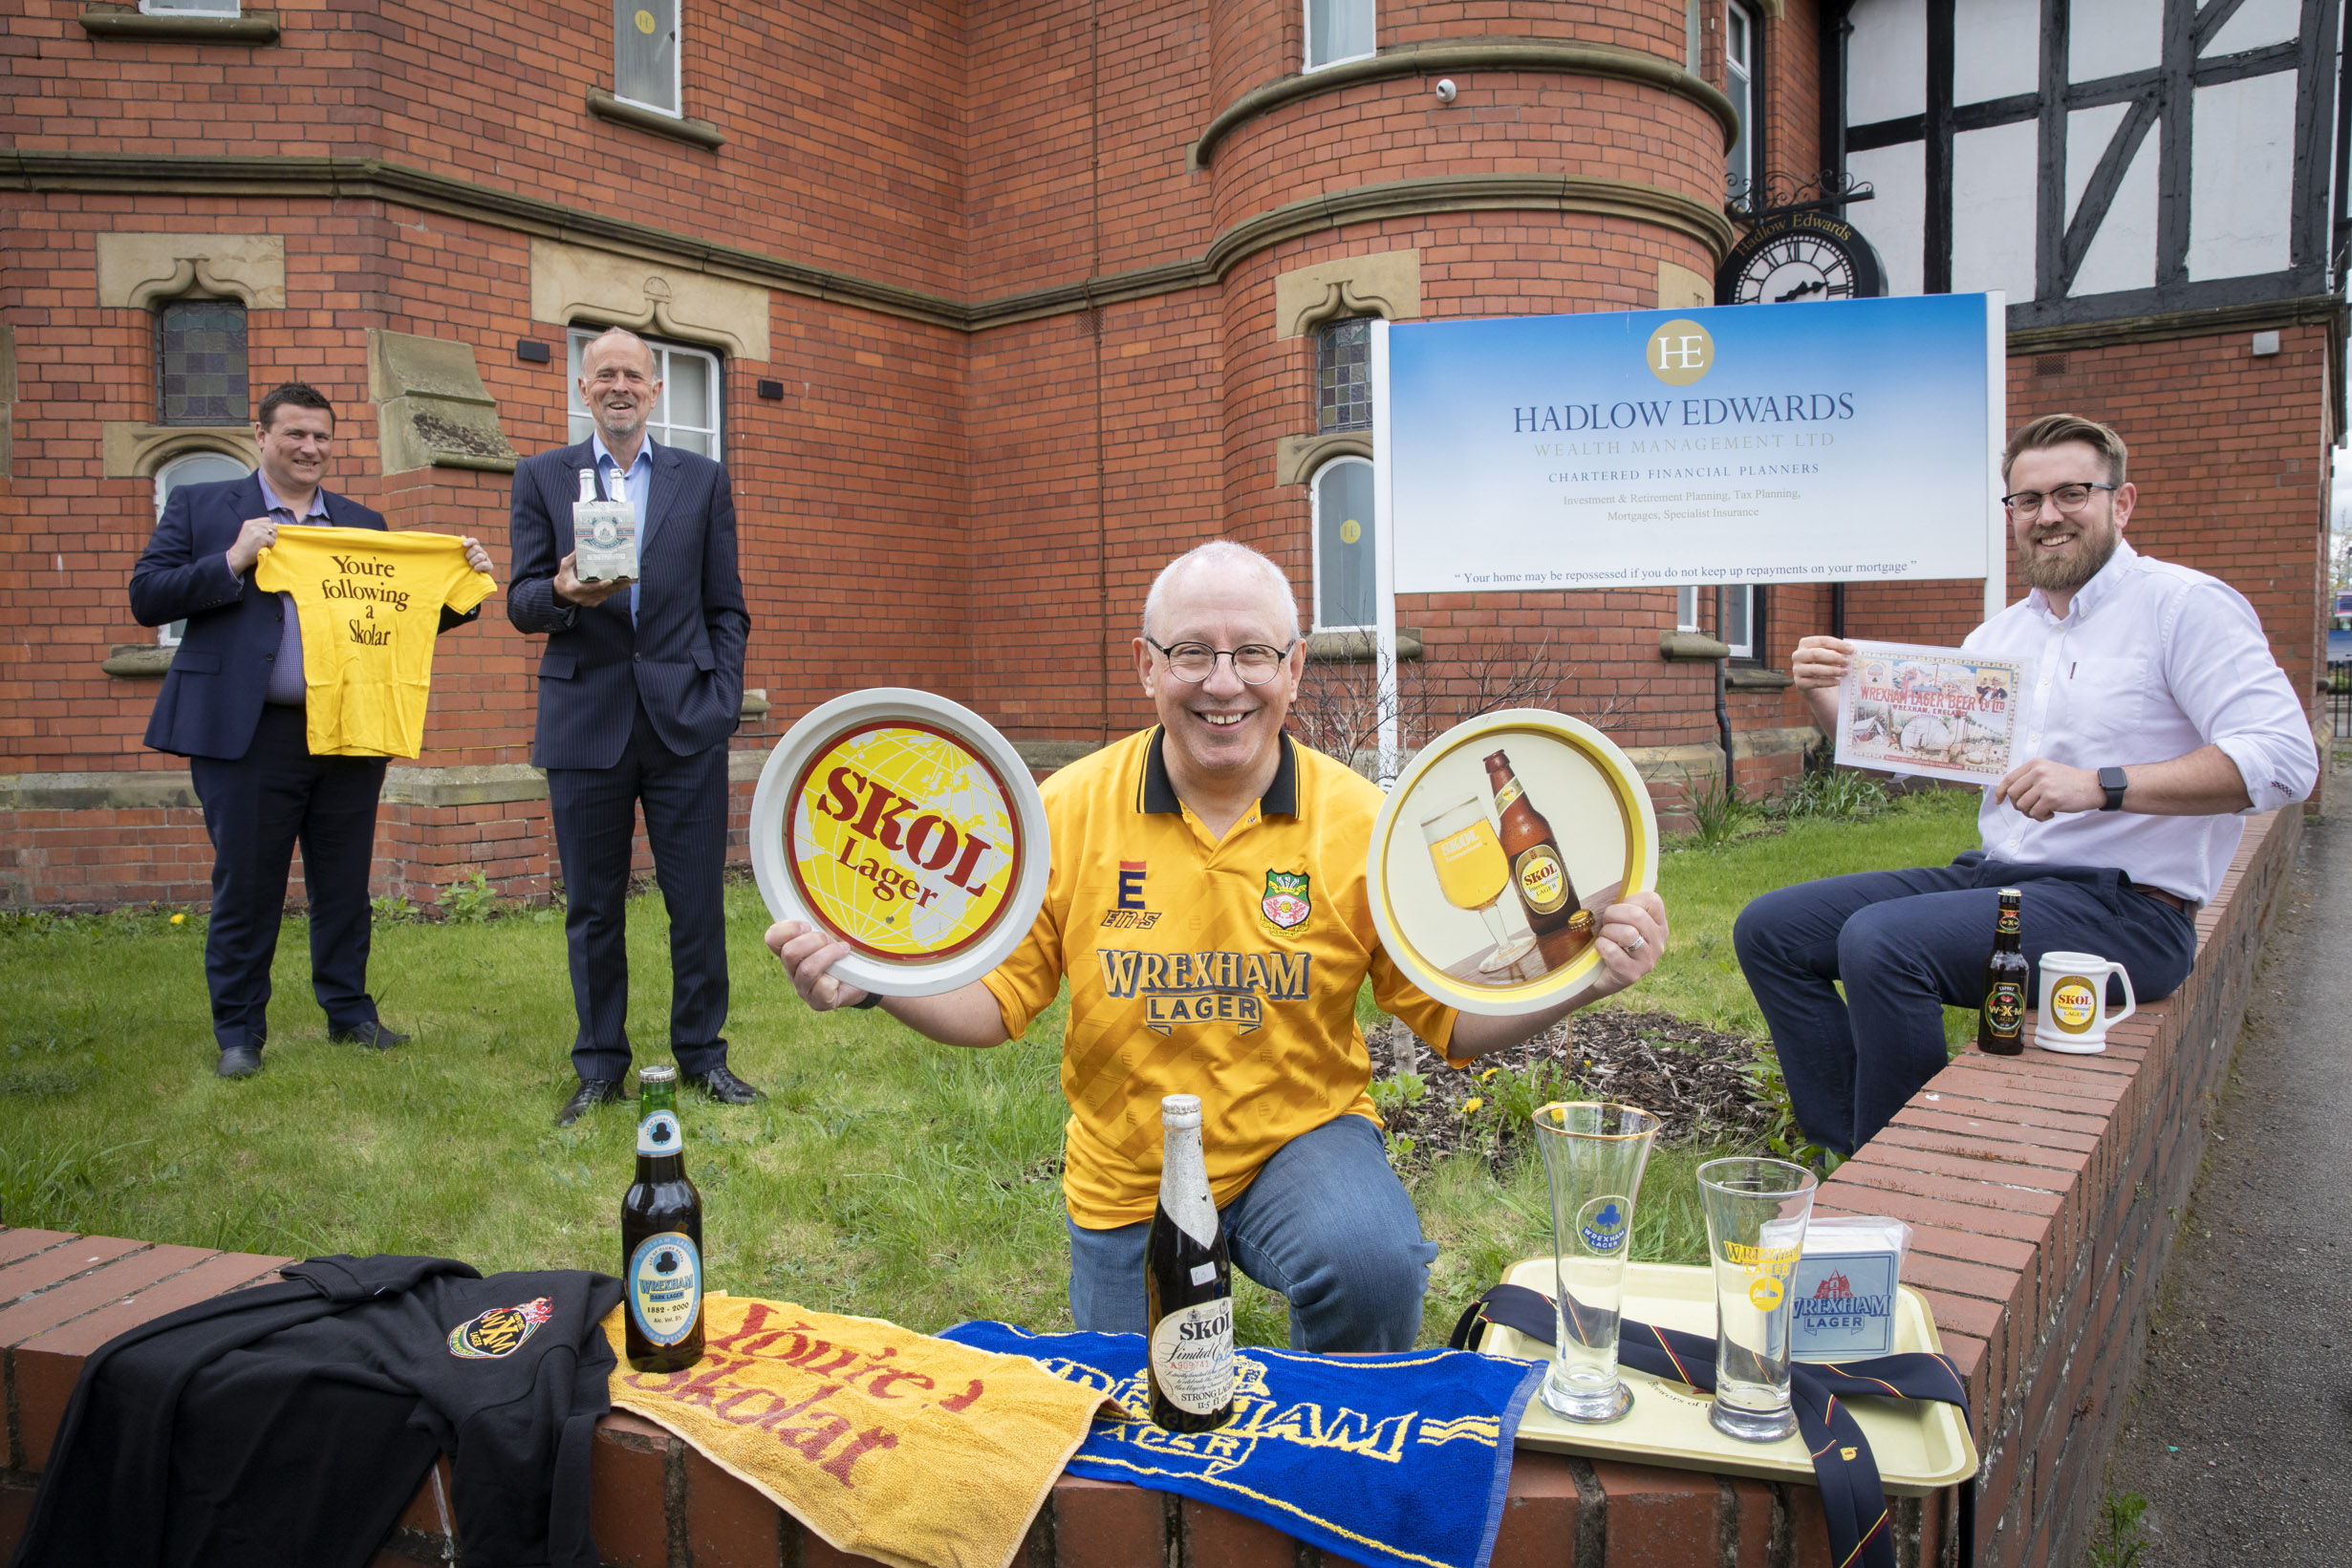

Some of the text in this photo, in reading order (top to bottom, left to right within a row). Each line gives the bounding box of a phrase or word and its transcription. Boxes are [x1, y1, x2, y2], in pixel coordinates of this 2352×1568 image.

[1736, 213, 1852, 257] Hadlow Edwards
[1657, 334, 1705, 370] HE
[1514, 393, 1854, 433] HADLOW EDWARDS
[1534, 432, 1835, 458] WEALTH MANAGEMENT LTD
[1548, 463, 1820, 483] CHARTERED FINANCIAL PLANNERS
[1564, 488, 1802, 505] Investment & Retirement Planning, Tax Planning,
[1608, 507, 1759, 525] Mortgages, Specialist Insurance
[330, 555, 395, 578] You're
[1463, 572, 1490, 583] Your
[1493, 572, 1521, 582] home
[1524, 573, 1545, 584] may
[1550, 570, 1563, 580] be
[1565, 568, 1628, 582] repossessed
[1629, 568, 1640, 578] if
[1641, 569, 1661, 581] you
[1664, 567, 1678, 577] do
[1681, 567, 1697, 577] not
[1701, 566, 1726, 578] keep
[1730, 567, 1743, 577] up
[1746, 564, 1808, 577] repayments
[1811, 564, 1824, 573] on
[1827, 563, 1853, 574] your
[1856, 561, 1908, 574] mortgage
[321, 579, 410, 612] following
[365, 605, 374, 619] a
[349, 619, 391, 646] Skolar
[1860, 685, 1908, 705] WREXHAM
[1910, 690, 1944, 708] LAGER
[1948, 695, 1976, 712] BEER
[1931, 707, 1967, 717] ENGLAND
[816, 766, 992, 898] SKOL
[1441, 828, 1480, 857] SKOL
[836, 835, 939, 909] Lager
[1523, 864, 1558, 887] SKOL
[1529, 873, 1560, 892] International
[1536, 883, 1557, 897] LAGER
[1097, 949, 1312, 1000] WREXHAM
[1151, 996, 1257, 1020] LAGER
[2058, 994, 2092, 1005] SKOL
[2058, 1003, 2091, 1012] International
[1584, 1228, 1626, 1242] WREXHAM
[1590, 1239, 1619, 1249] LAGER
[1723, 1240, 1803, 1263] WREXHAM
[1744, 1263, 1790, 1275] LAGER
[638, 1274, 695, 1295] WREXHAM
[650, 1292, 684, 1301] DARK LAGER
[672, 1301, 690, 1312] 2000
[1179, 1311, 1232, 1342] SKOL
[1806, 1318, 1863, 1328] LAGER
[1157, 1340, 1216, 1364] Limited
[1170, 1360, 1210, 1370] A909741
[1181, 1389, 1217, 1402] STRONG
[1213, 1397, 1219, 1406] fl
[1647, 1380, 1684, 1404] Brewers
[1096, 1424, 1241, 1457] AGER
